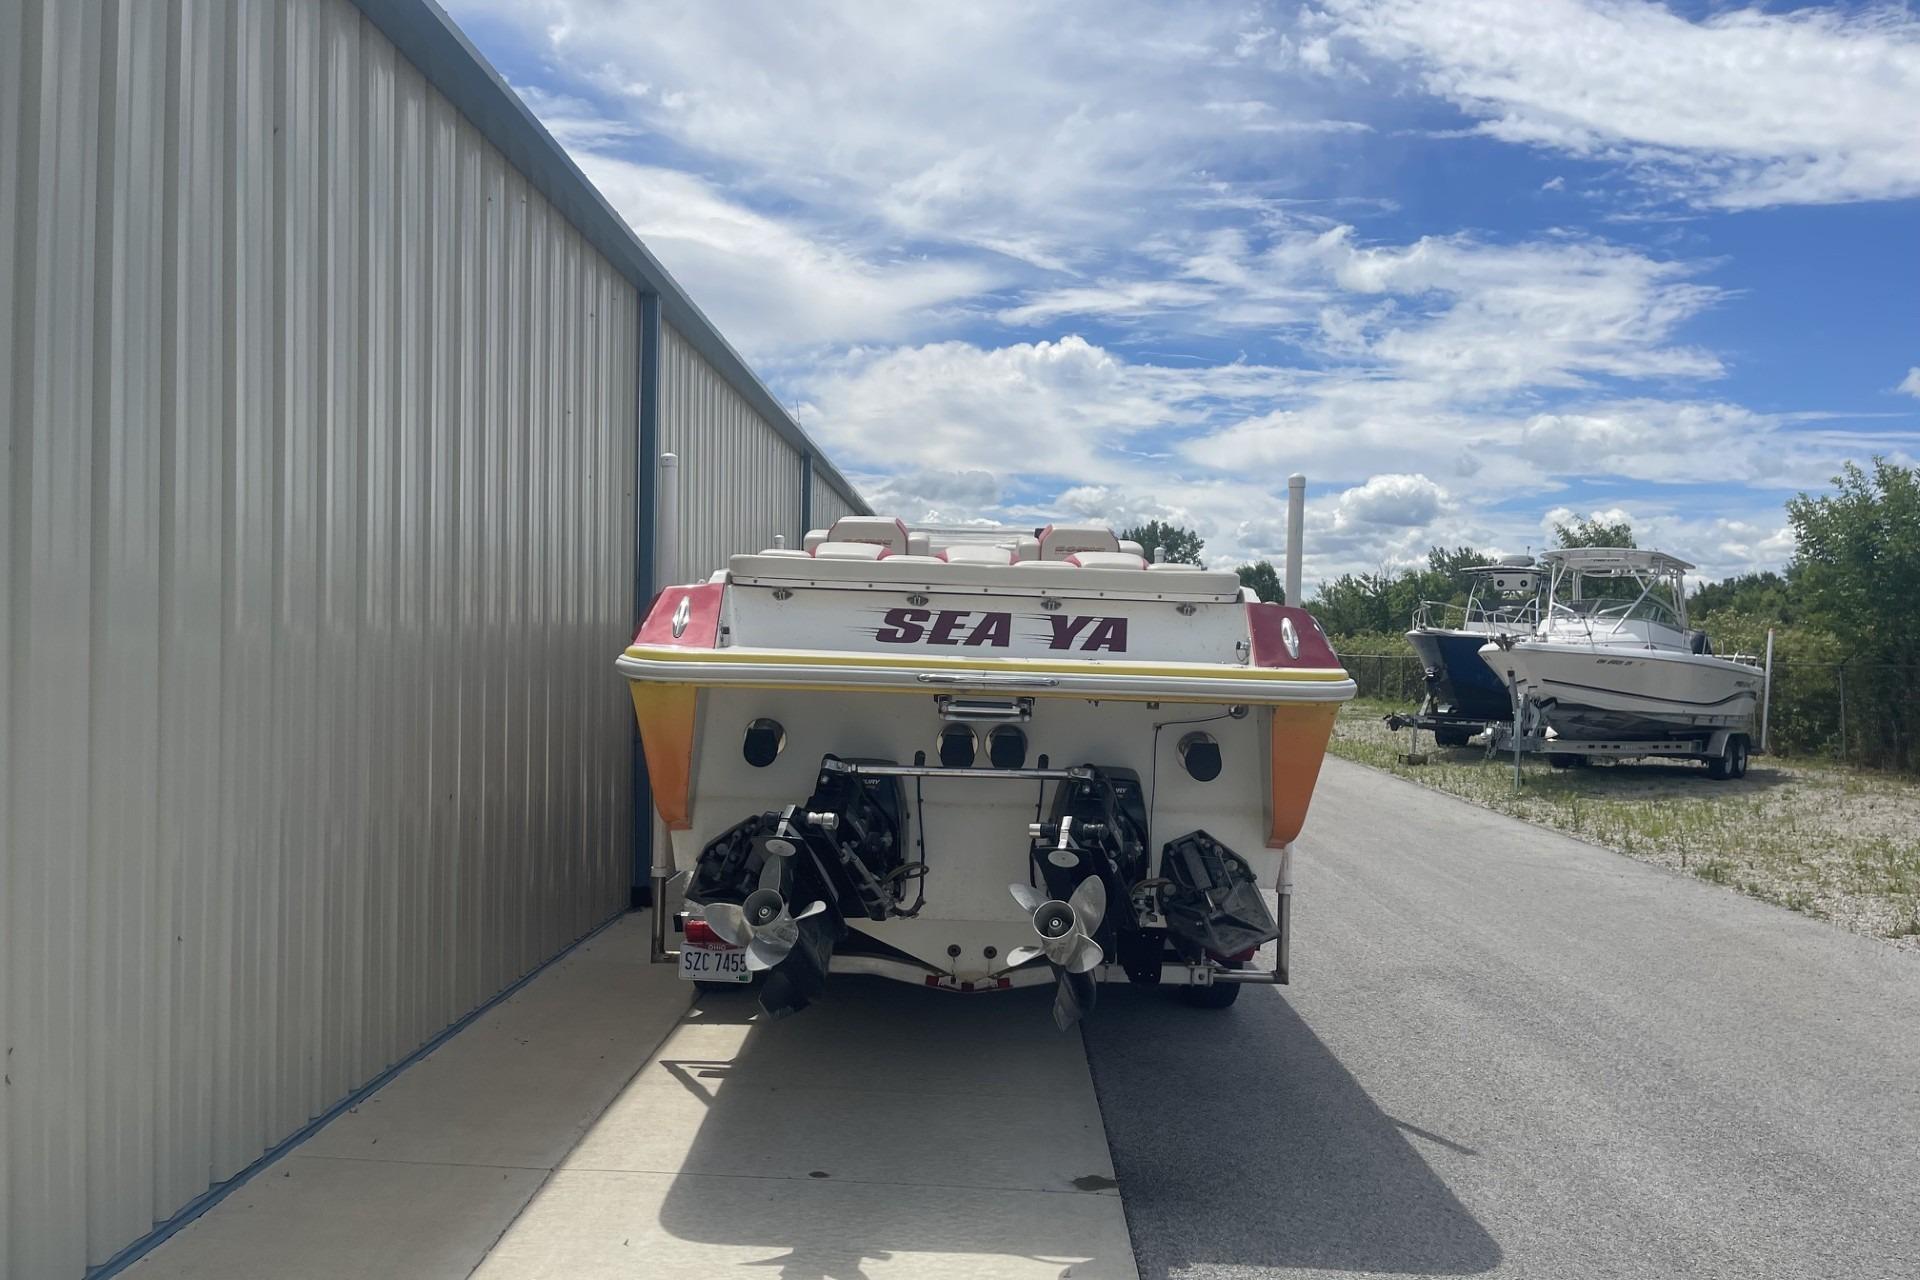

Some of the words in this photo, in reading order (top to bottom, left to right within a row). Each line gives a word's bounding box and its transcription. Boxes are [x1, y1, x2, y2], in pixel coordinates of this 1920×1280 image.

[875, 607, 1012, 648] SEA
[1048, 614, 1129, 653] YA
[684, 951, 710, 971] SZC
[715, 952, 747, 972] 7455
